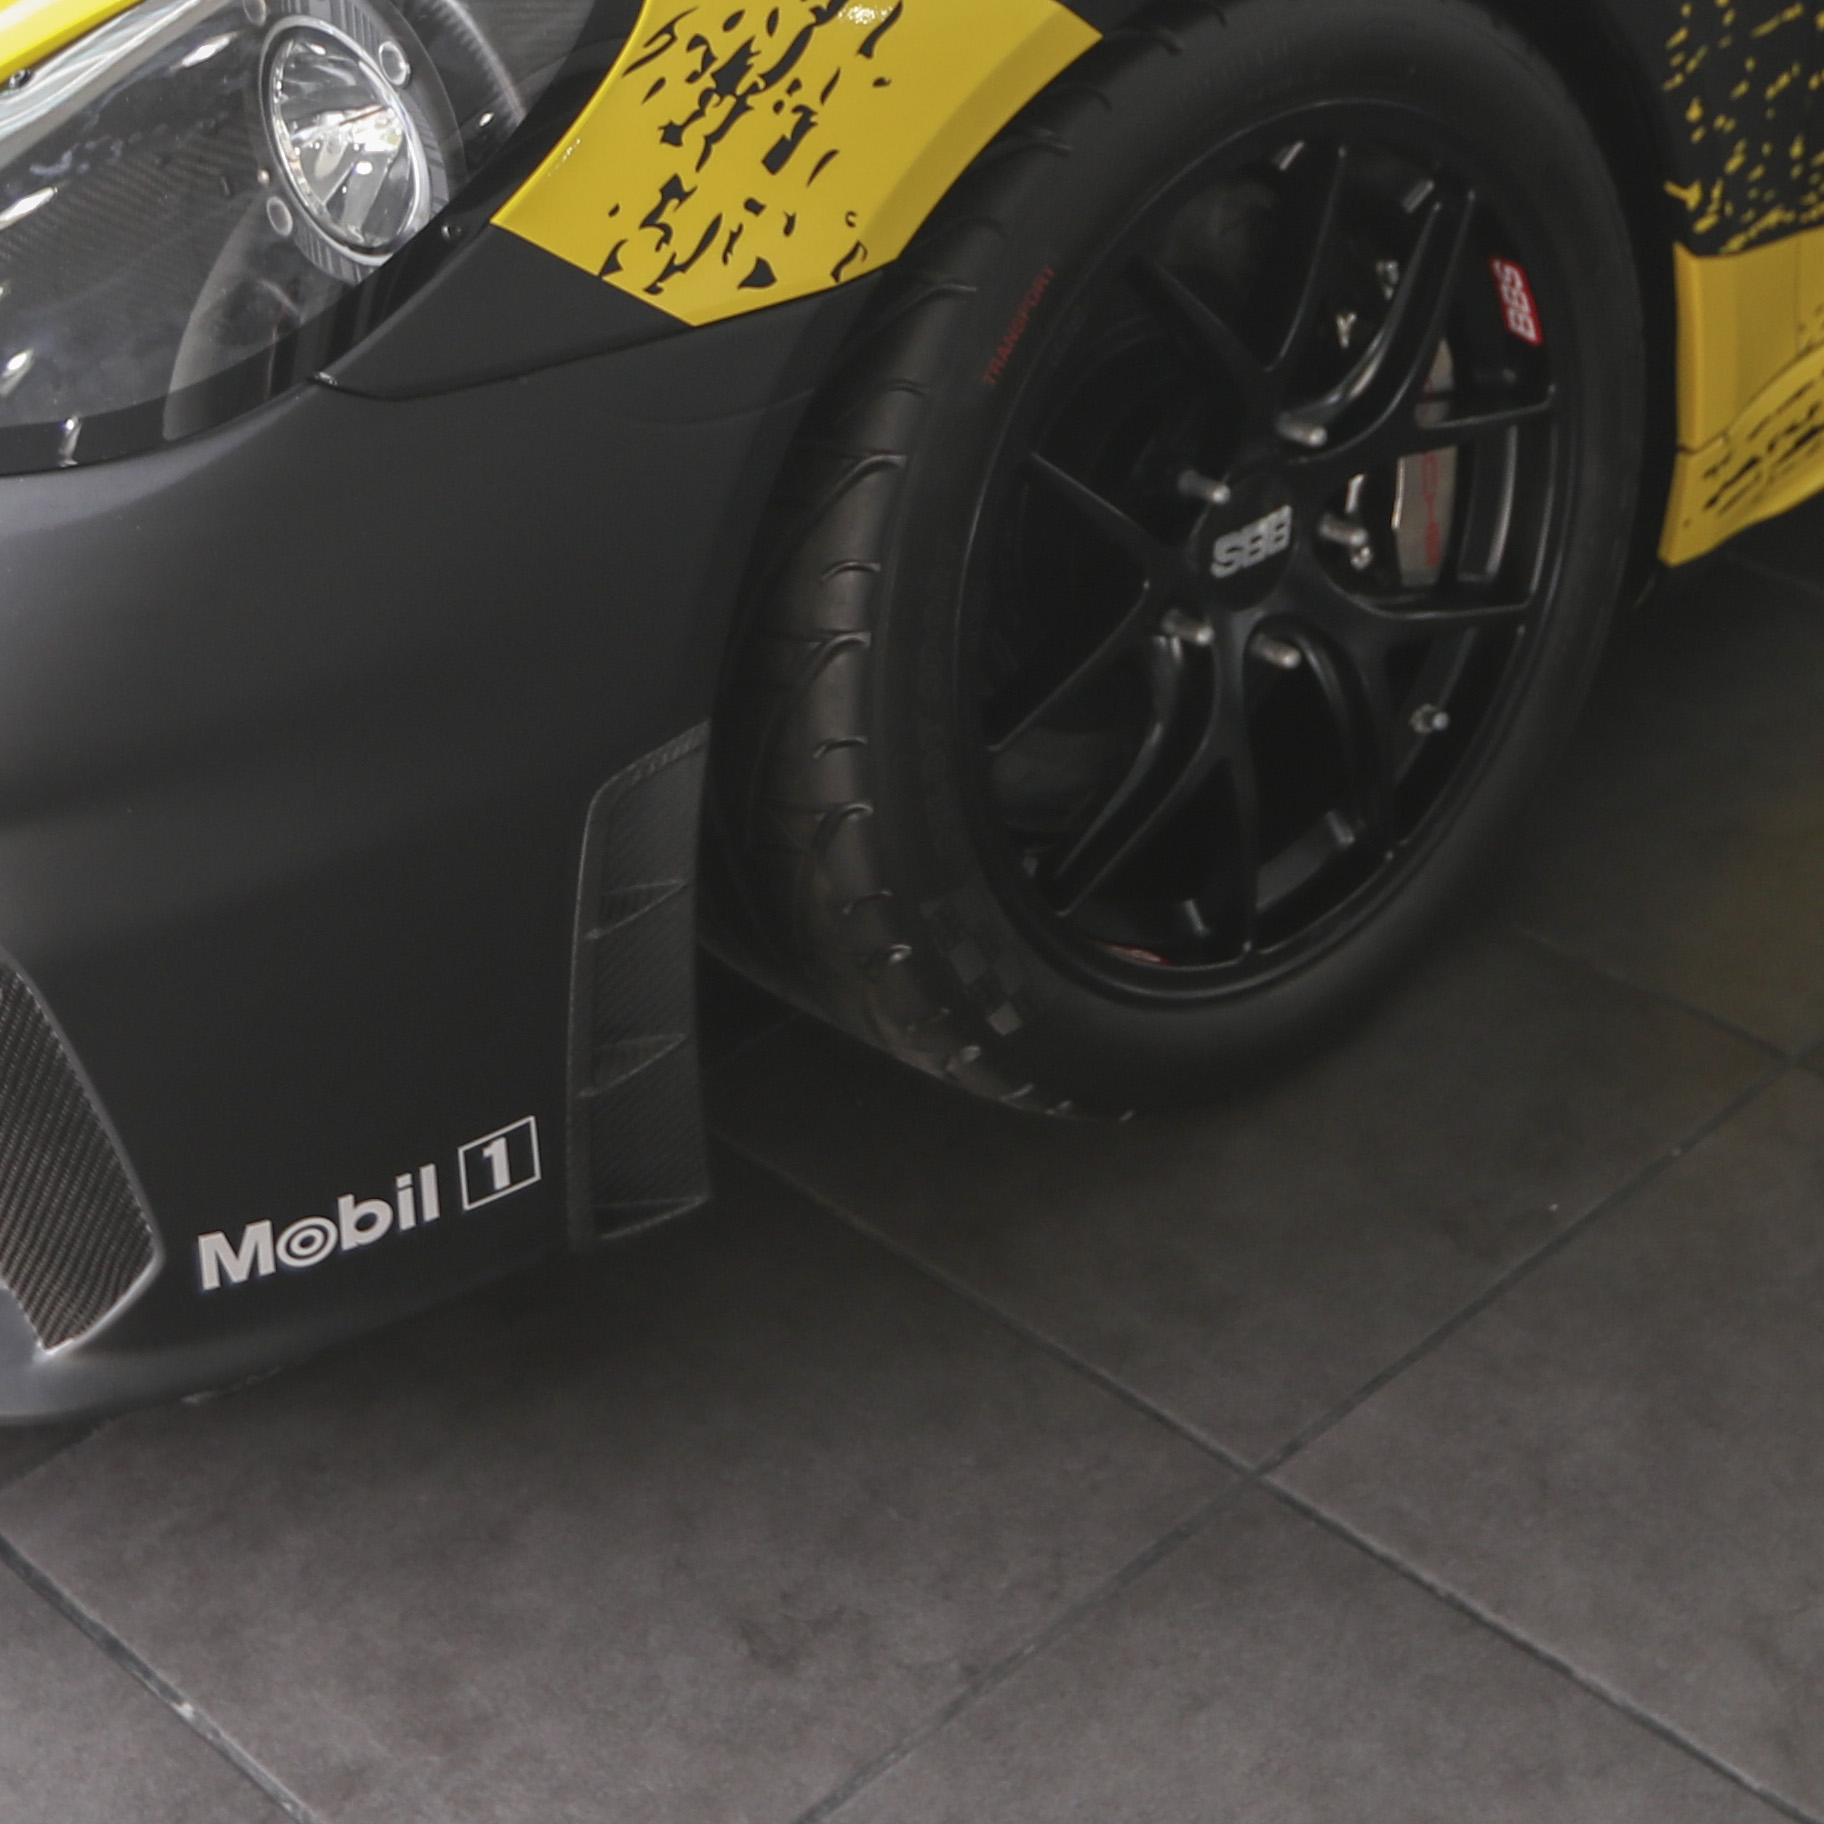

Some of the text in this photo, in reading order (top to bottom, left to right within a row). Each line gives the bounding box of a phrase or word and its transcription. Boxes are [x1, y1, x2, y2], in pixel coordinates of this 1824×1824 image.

[982, 265, 1055, 385] TRANSPORT
[1492, 259, 1538, 342] BBS
[1210, 505, 1293, 578] BBS
[197, 1136, 512, 1291] Mobil 1
